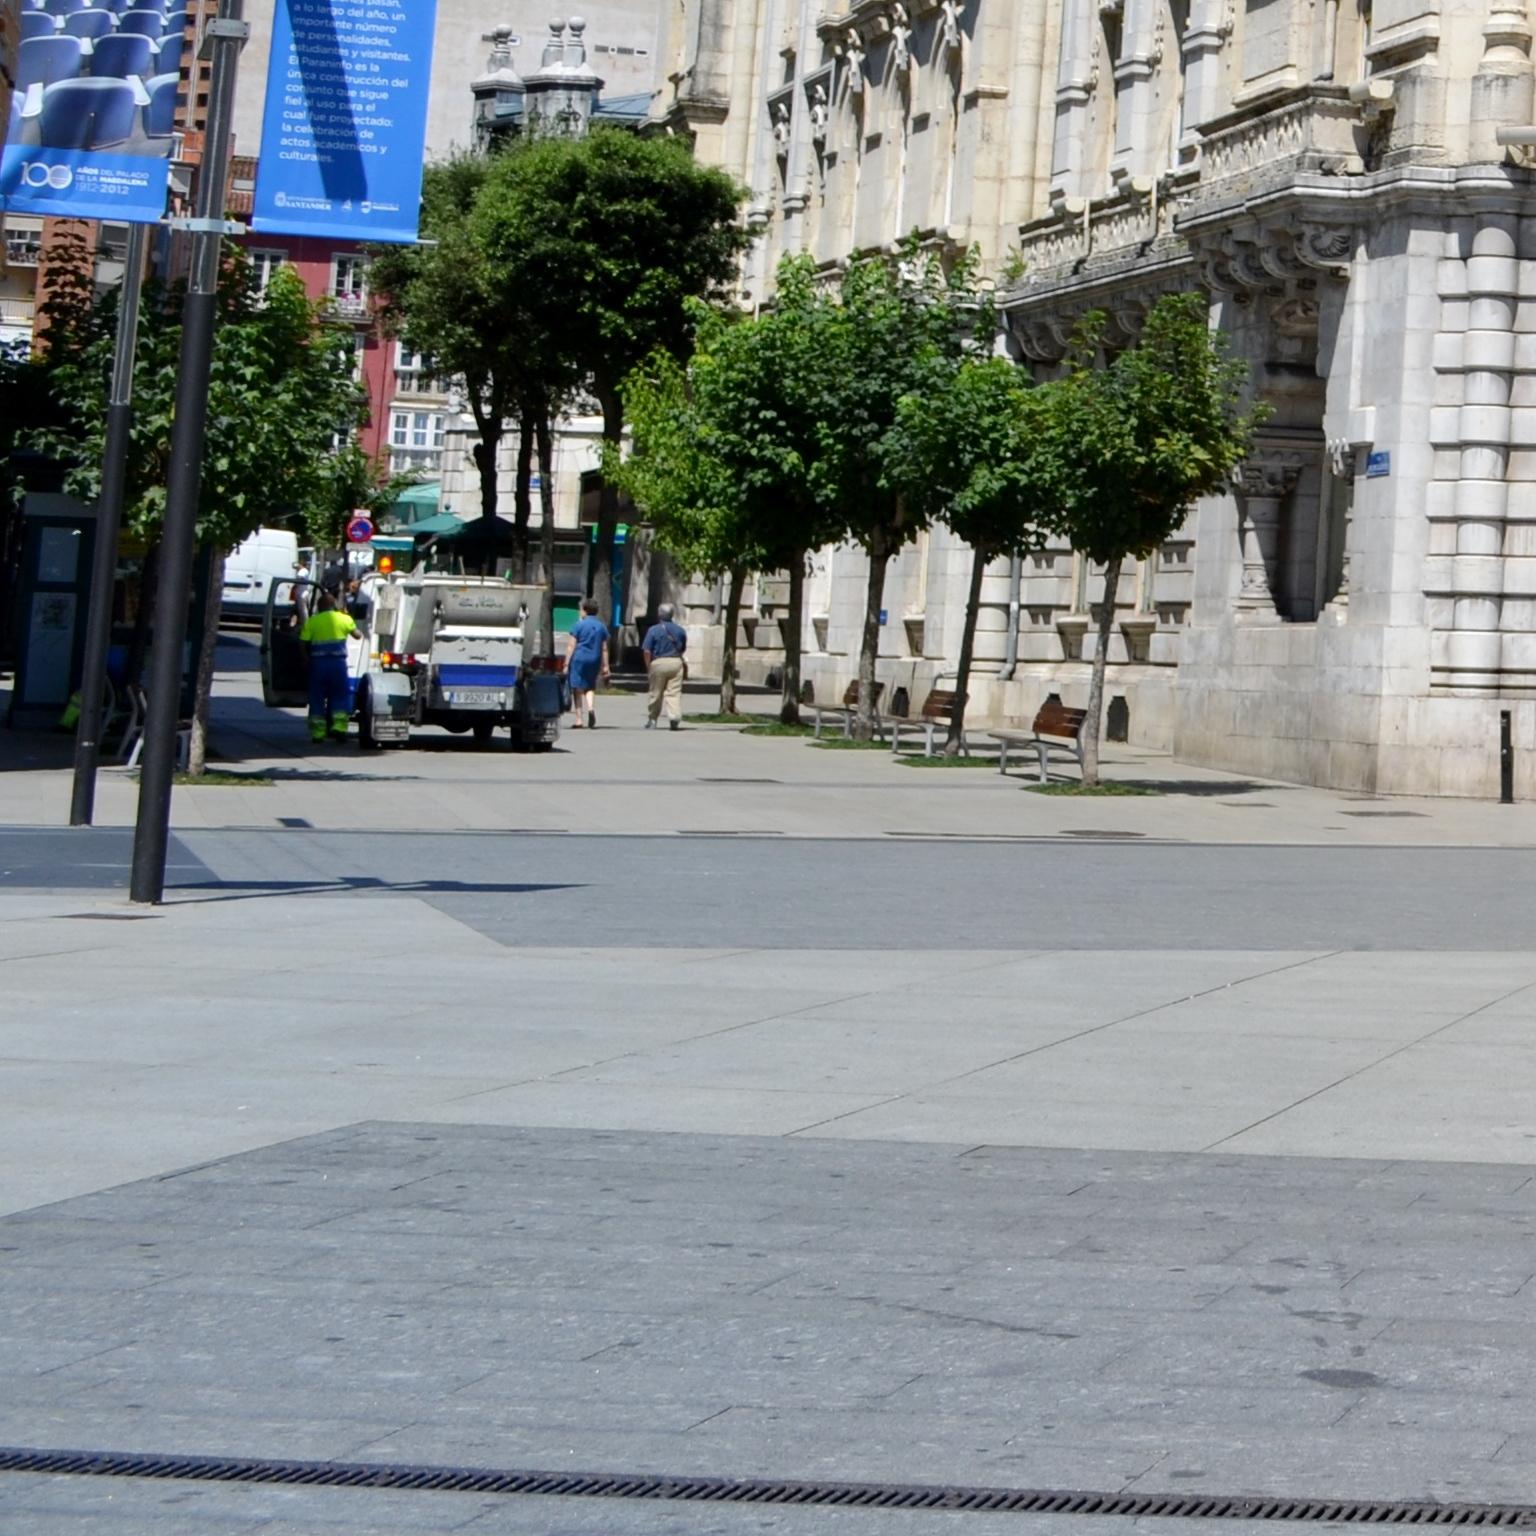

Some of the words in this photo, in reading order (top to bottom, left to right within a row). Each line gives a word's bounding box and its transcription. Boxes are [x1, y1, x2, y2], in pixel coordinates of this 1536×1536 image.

[317, 5, 344, 16] largo
[346, 8, 364, 17] del
[289, 45, 349, 56] estudiantes
[391, 79, 408, 87] del
[360, 90, 389, 100] sigue
[285, 97, 302, 106] fiel
[283, 112, 306, 120] cual
[280, 138, 310, 147] actos
